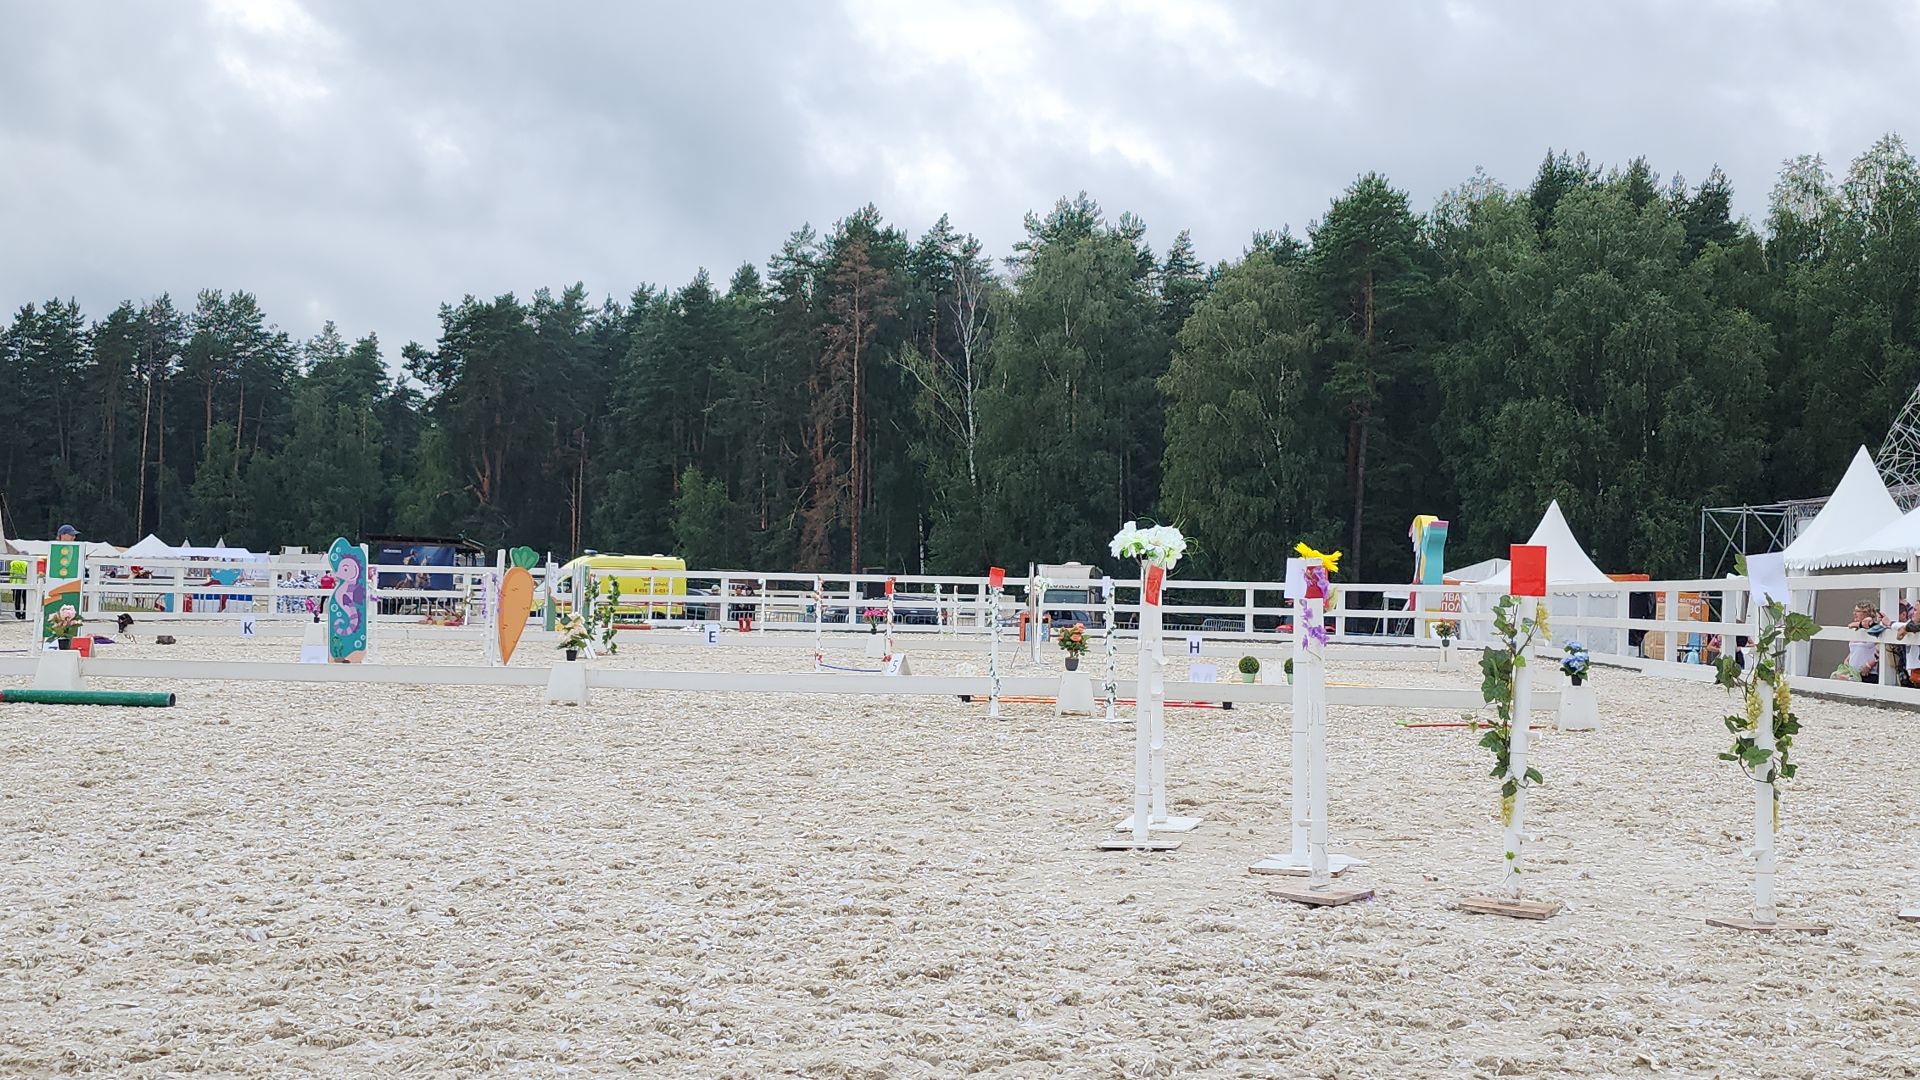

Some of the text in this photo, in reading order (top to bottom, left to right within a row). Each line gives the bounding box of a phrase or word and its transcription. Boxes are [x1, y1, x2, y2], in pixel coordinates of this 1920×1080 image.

[243, 621, 254, 635] K
[708, 630, 717, 643] E
[1189, 641, 1200, 654] H
[890, 659, 899, 673] 5
